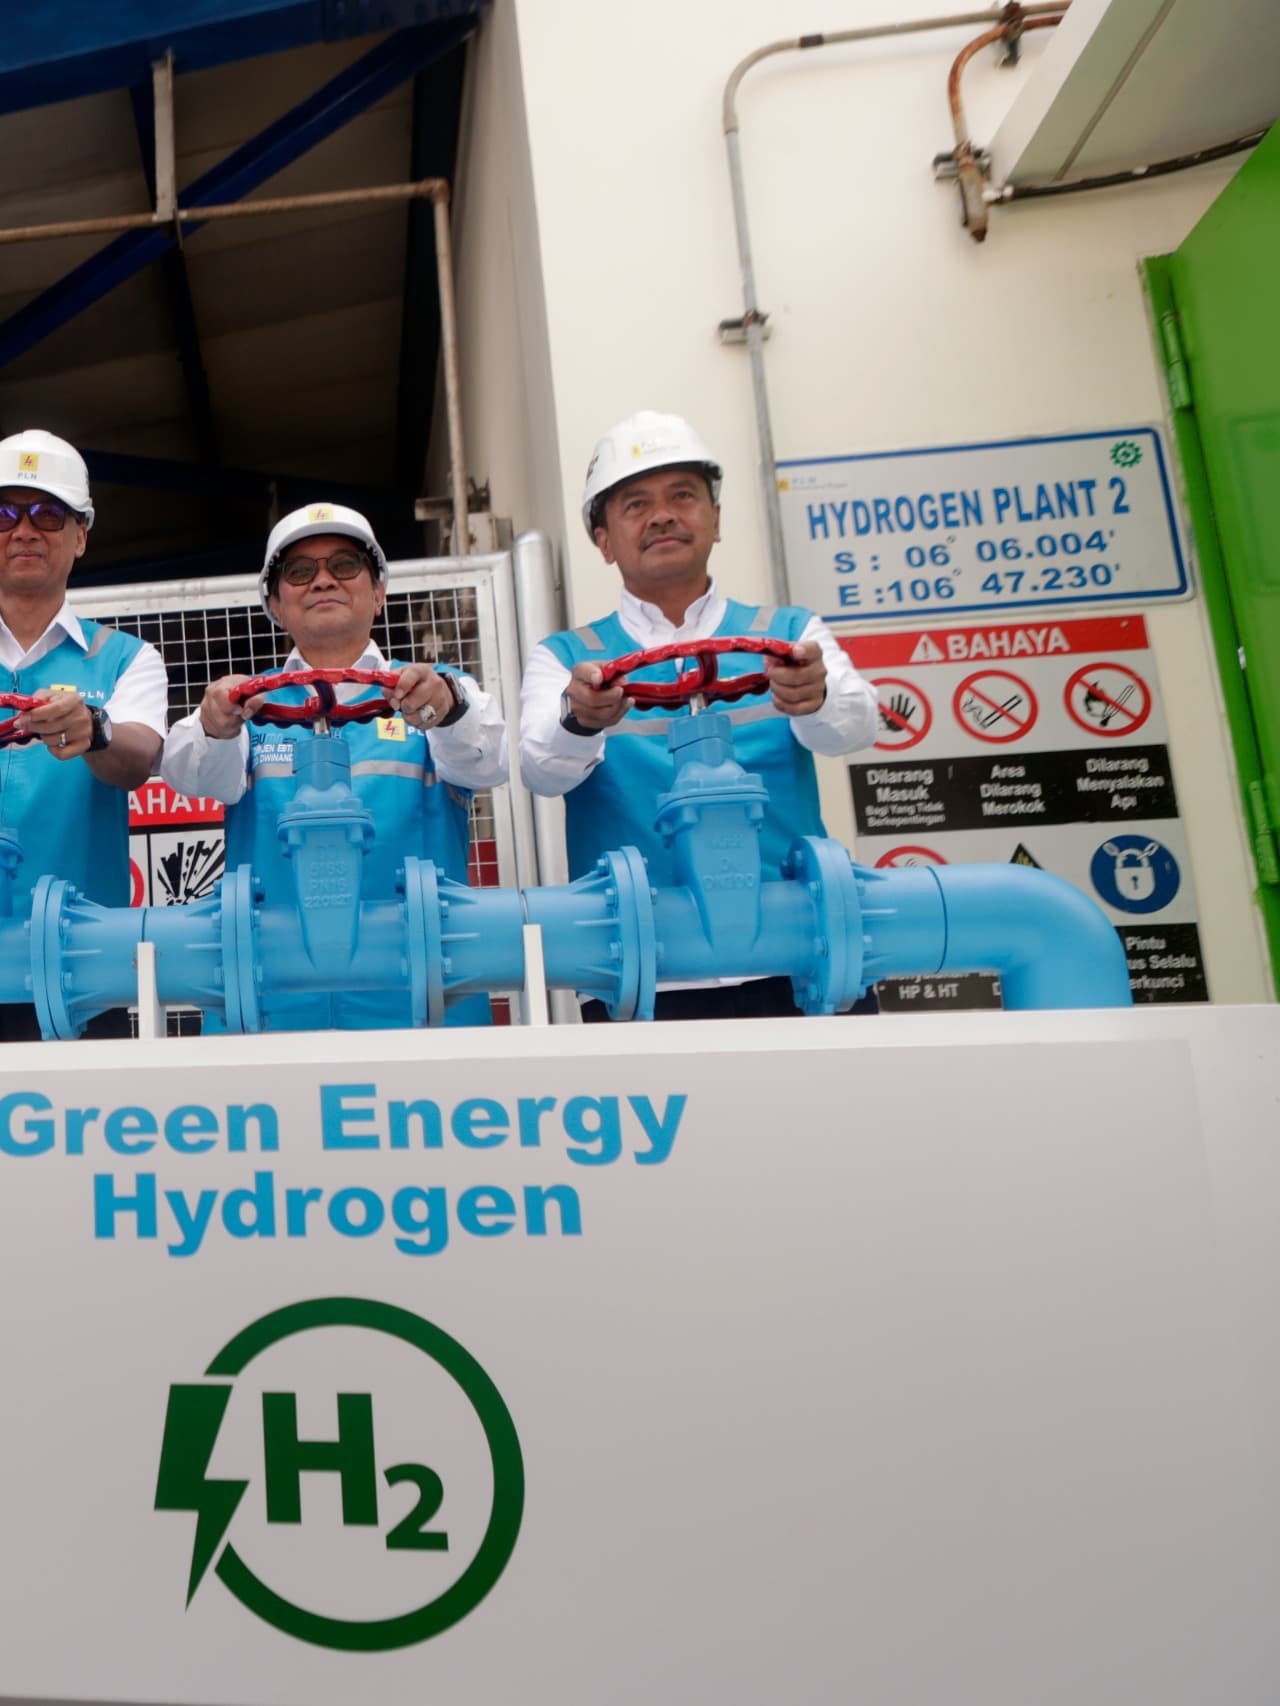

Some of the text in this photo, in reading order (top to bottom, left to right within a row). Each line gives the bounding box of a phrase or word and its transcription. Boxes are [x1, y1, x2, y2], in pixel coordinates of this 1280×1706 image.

[807, 476, 1132, 540] HYDROGEN PLANT 2
[946, 626, 1070, 661] BAHAYA
[407, 725, 425, 736] PL
[990, 764, 1026, 780] Area
[1085, 758, 1150, 773] Dilarang
[866, 768, 934, 785] Dilarang
[1076, 774, 1165, 793] Menyalakan
[876, 785, 930, 803] Masuk
[980, 782, 1042, 798] Dilarang
[128, 787, 225, 816] AHA
[982, 798, 1046, 816] Merokok
[1110, 793, 1138, 811] Api
[1125, 936, 1167, 951] Pintu
[1148, 954, 1197, 970] Selalu
[1128, 973, 1185, 989] erkunci
[898, 983, 959, 999] HP & HT
[318, 1082, 689, 1167] Energy
[92, 1169, 583, 1258] Hydrogen
[262, 1391, 450, 1553] H2
